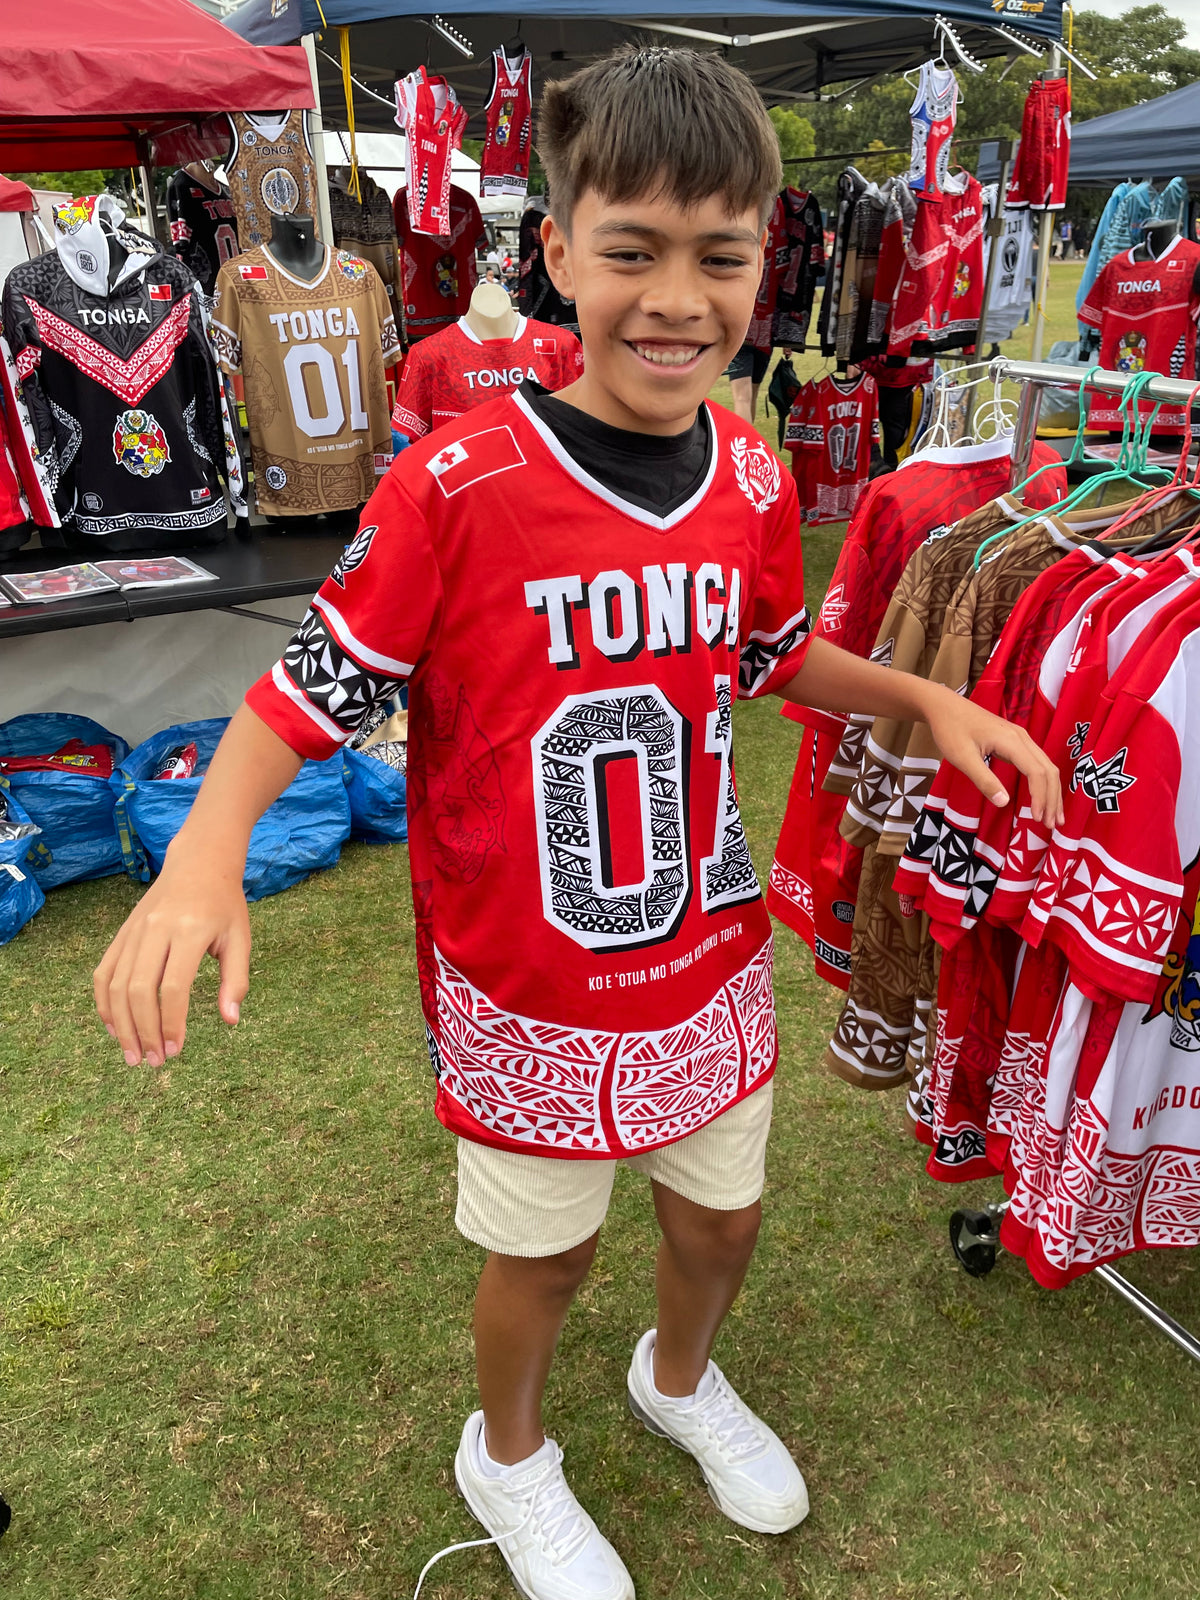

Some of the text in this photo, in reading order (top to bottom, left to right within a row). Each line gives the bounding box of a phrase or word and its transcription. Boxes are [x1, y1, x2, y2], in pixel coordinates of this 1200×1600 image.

[501, 88, 518, 98] TONGA
[255, 145, 294, 157] TONGA
[1117, 280, 1161, 294] TONGA
[78, 307, 151, 325] TONGA
[269, 307, 360, 343] TONGA
[283, 339, 369, 438] 01
[463, 366, 541, 389] TONGA
[827, 401, 862, 420] TONGA
[524, 562, 740, 667] TONGA
[530, 674, 763, 950] 01
[588, 976, 603, 992] KO
[606, 974, 612, 989] E
[649, 963, 667, 983] MO
[669, 951, 693, 976] TONGA
[694, 944, 703, 962] KO
[702, 933, 718, 955] HOKU
